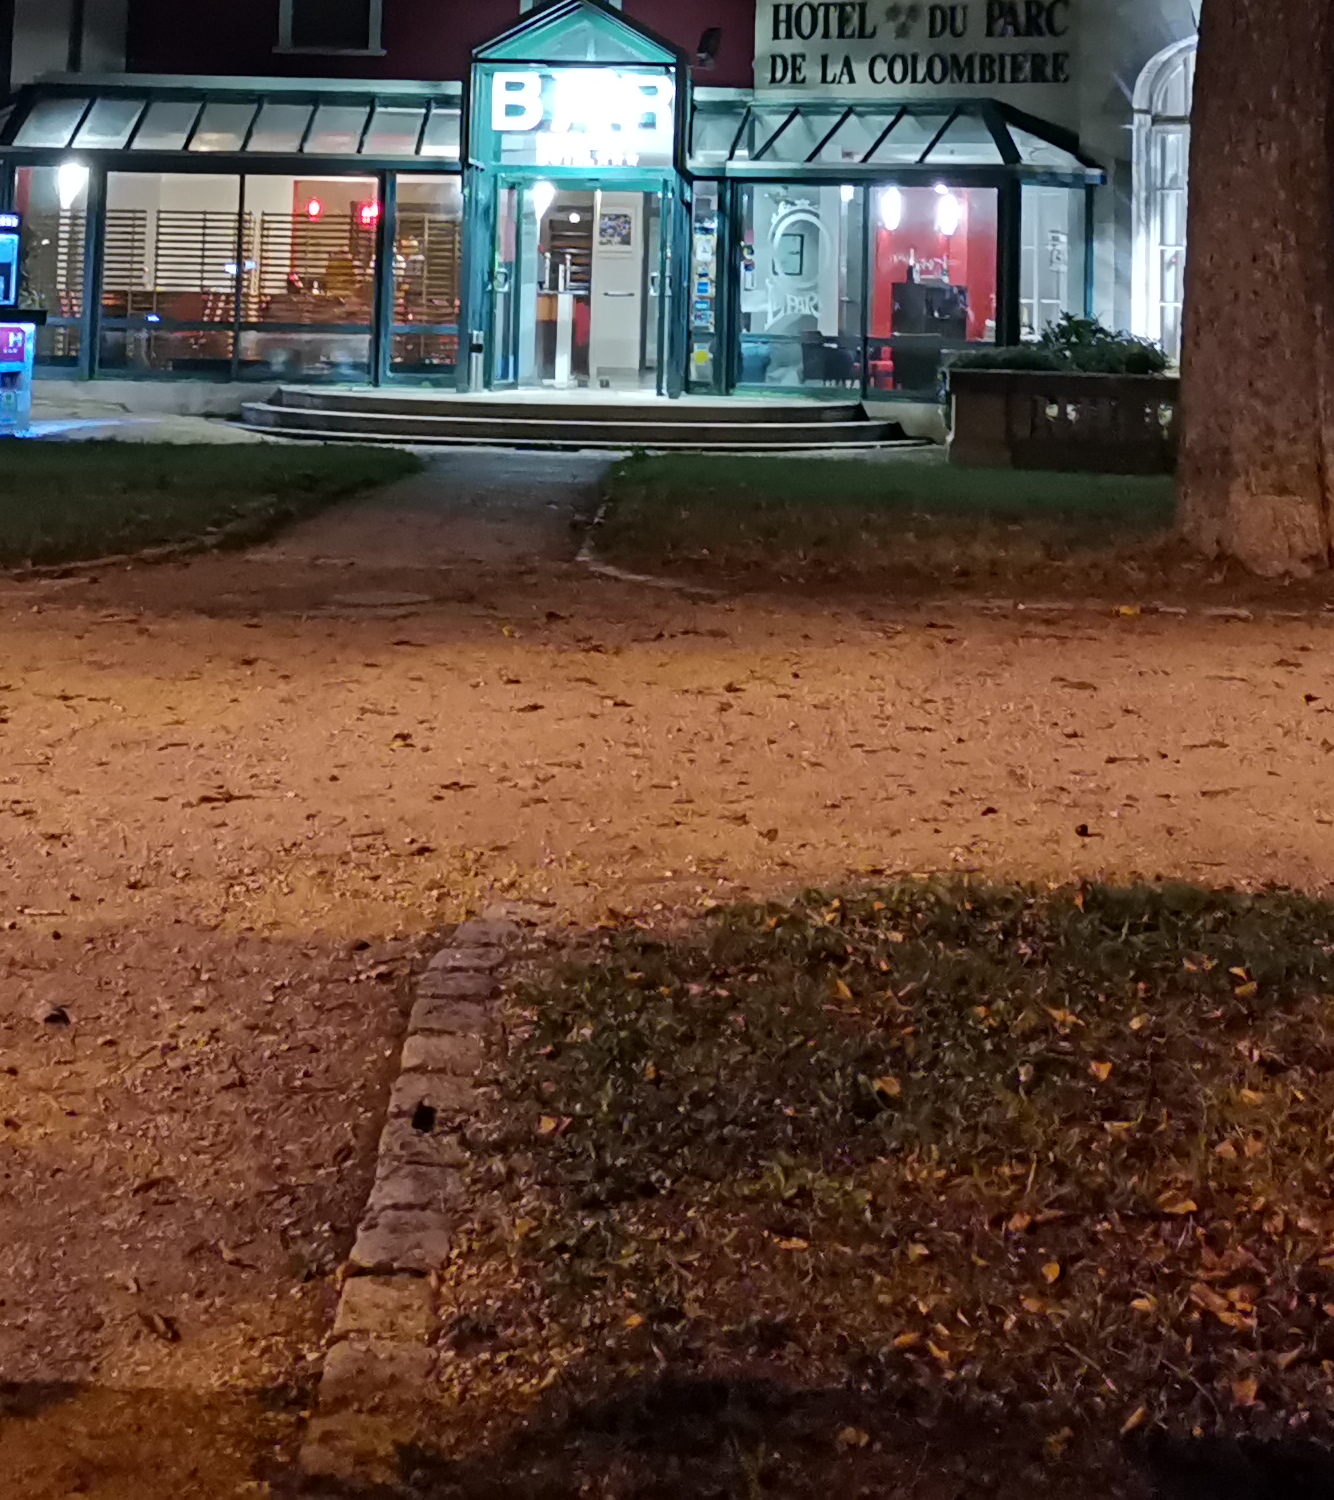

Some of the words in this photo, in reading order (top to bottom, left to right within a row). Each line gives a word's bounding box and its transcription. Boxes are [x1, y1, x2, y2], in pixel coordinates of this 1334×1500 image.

[771, 1, 877, 41] HOTEL
[928, 4, 969, 39] DU
[769, 53, 807, 85] DE
[820, 53, 857, 85] LA
[868, 51, 1071, 85] COLOMBIERE
